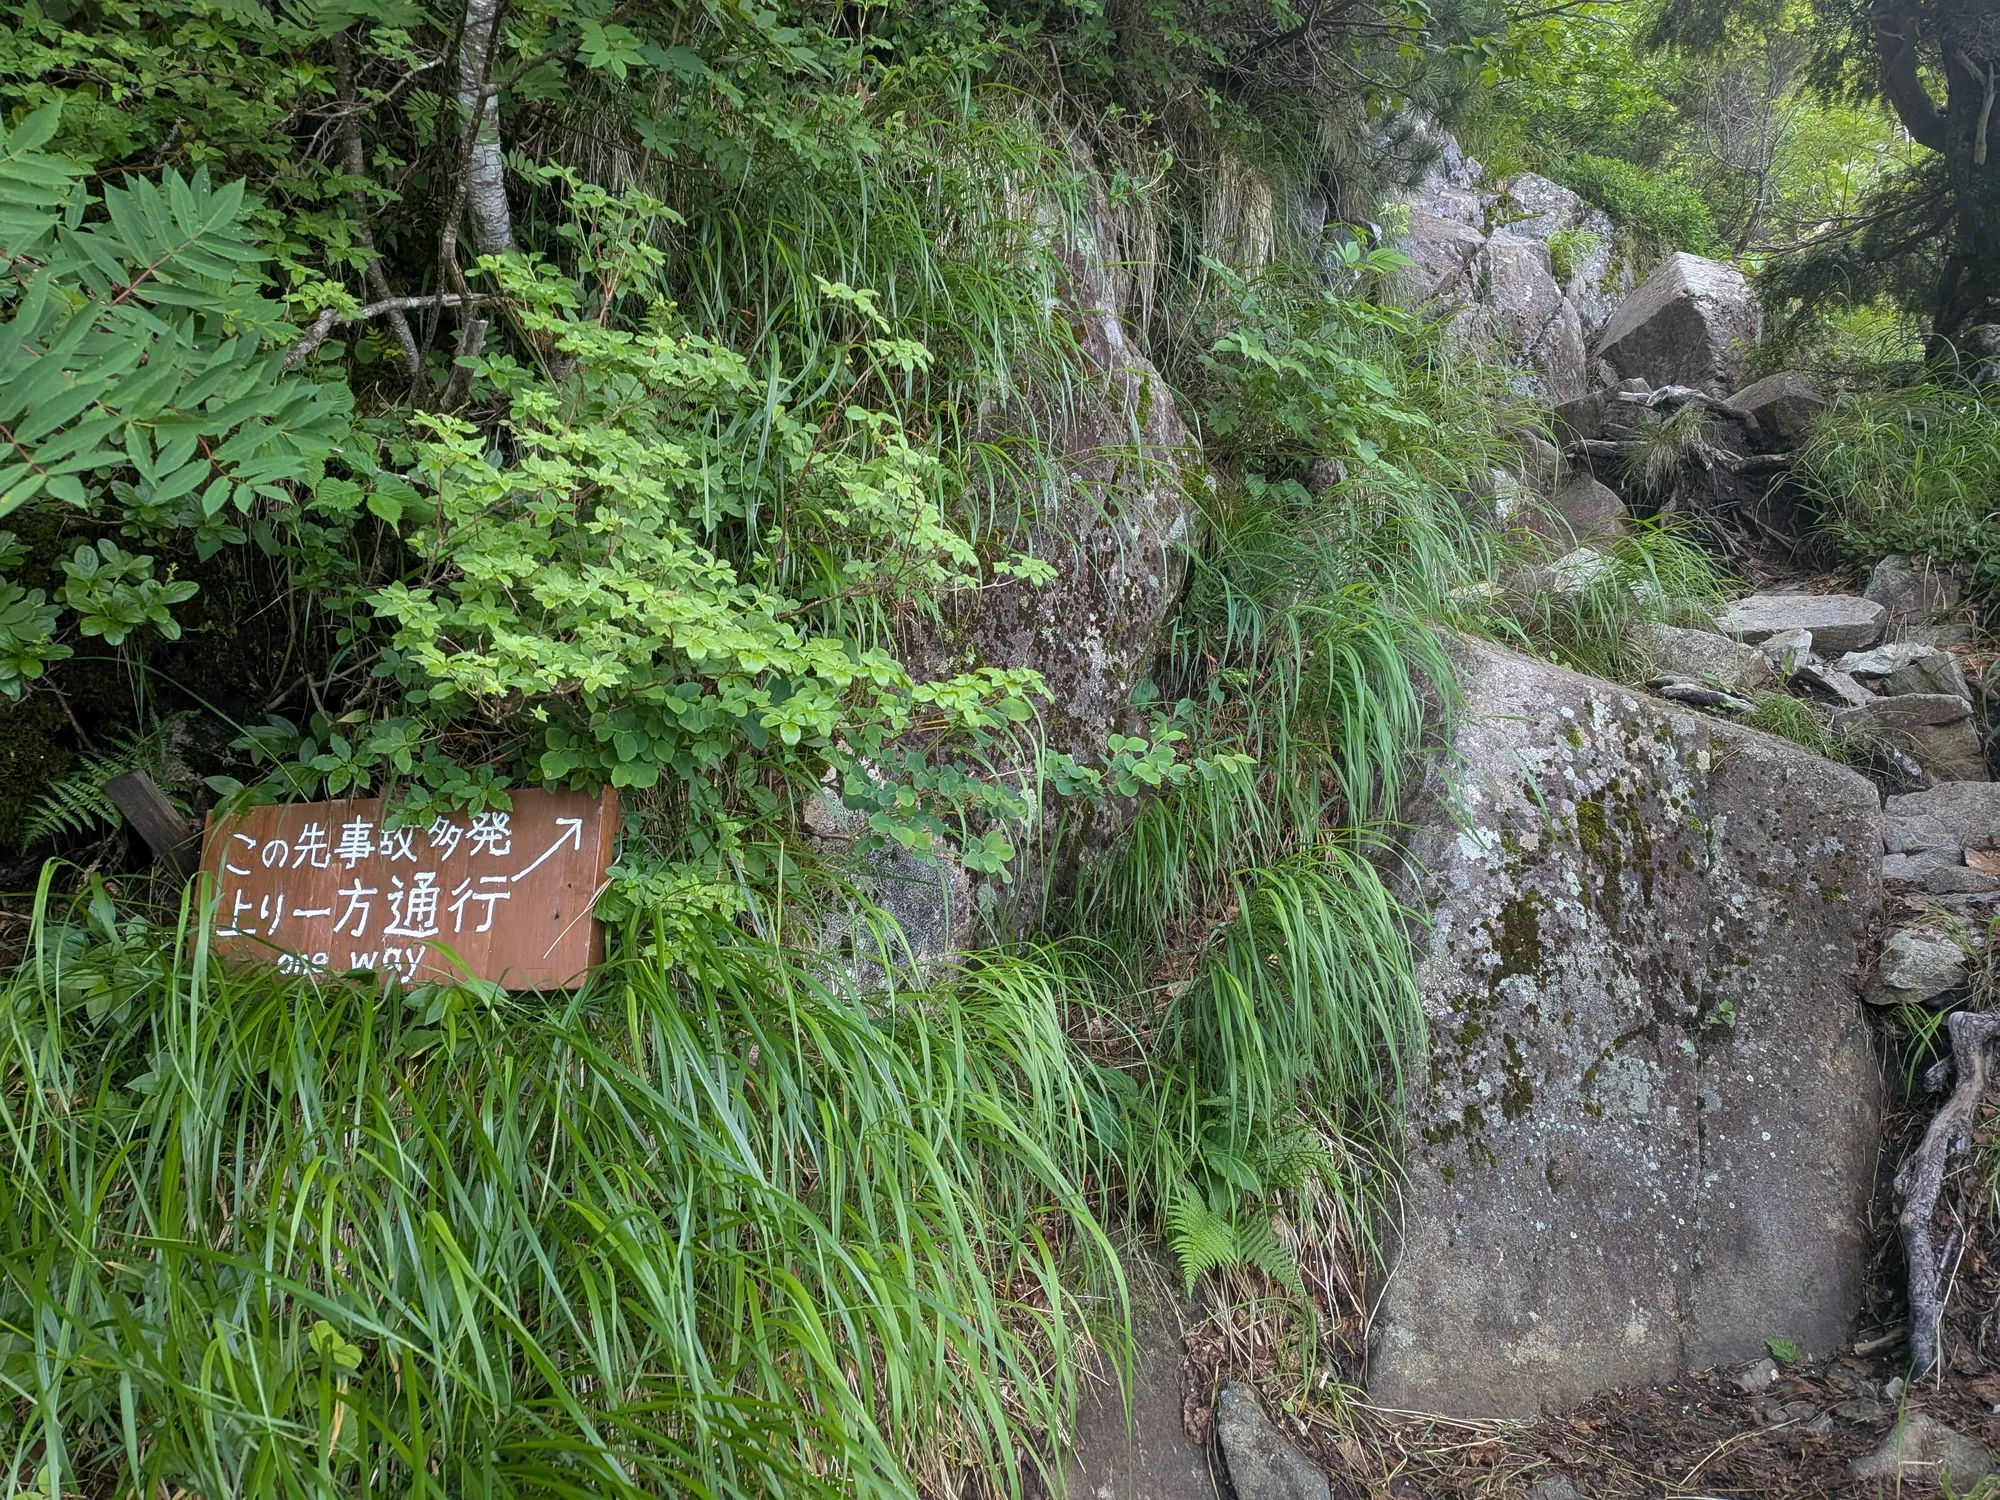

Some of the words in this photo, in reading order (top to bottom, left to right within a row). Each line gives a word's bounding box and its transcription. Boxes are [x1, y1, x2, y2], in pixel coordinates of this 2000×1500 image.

[226, 812, 511, 875] この先事故多発
[216, 872, 511, 938] 上り一方通行
[277, 952, 329, 976] one
[350, 945, 427, 984] way
